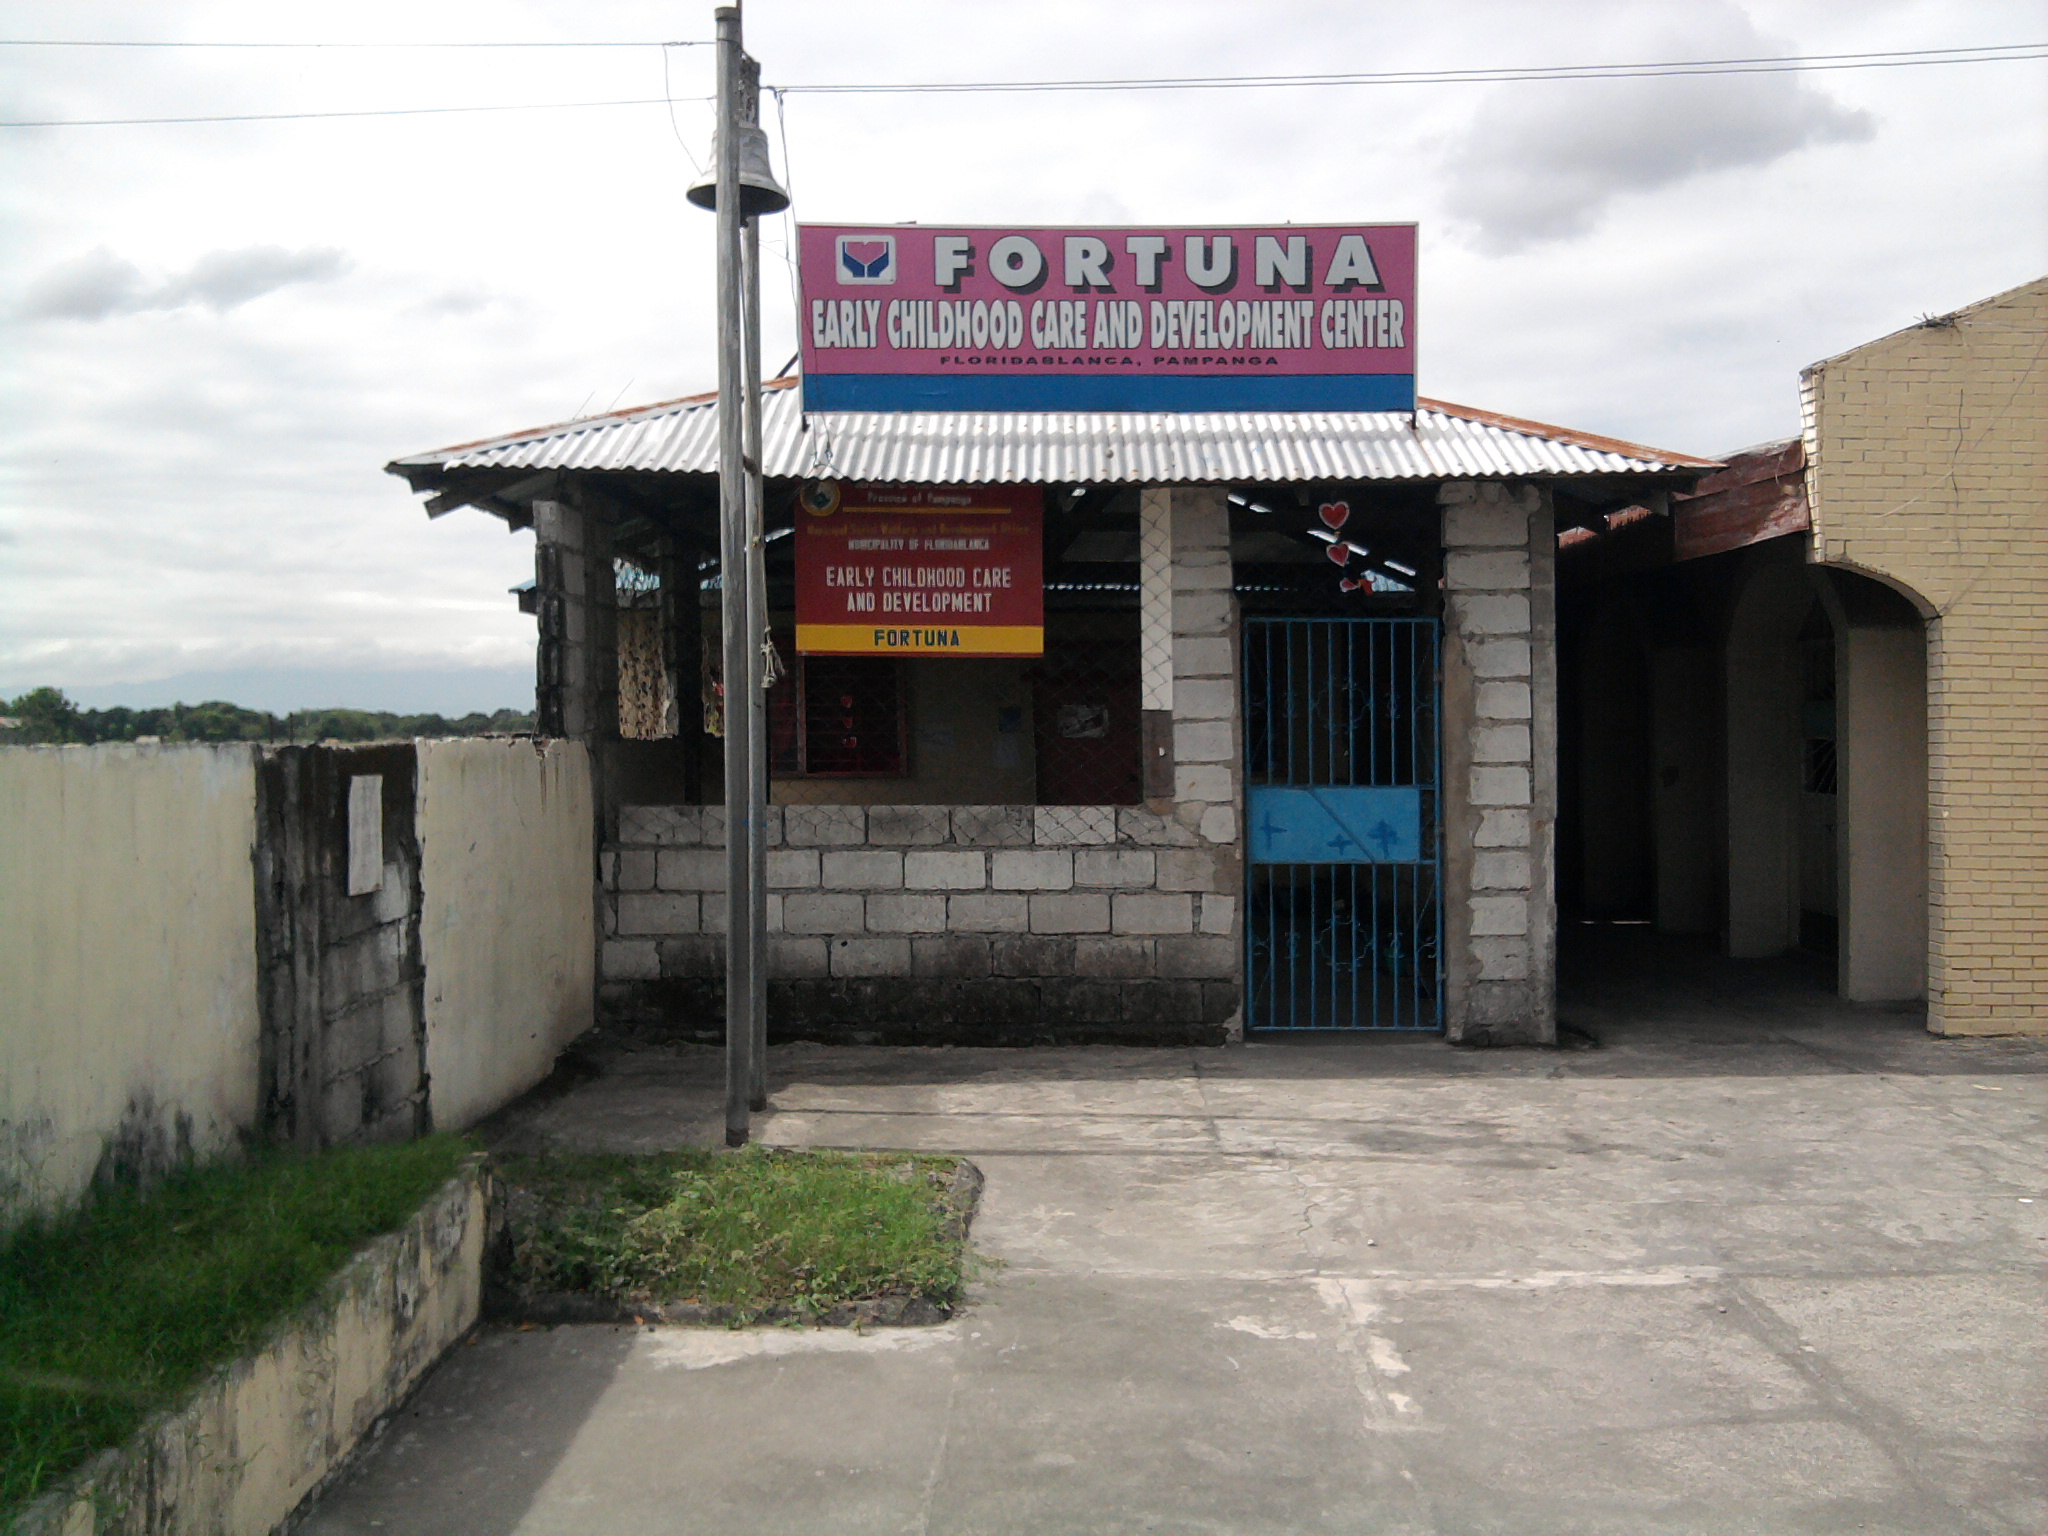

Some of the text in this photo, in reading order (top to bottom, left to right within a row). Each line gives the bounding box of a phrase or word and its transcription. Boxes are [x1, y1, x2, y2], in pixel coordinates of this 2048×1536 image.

[933, 234, 1382, 289] FORTUNA
[811, 299, 1405, 349] EARLY CHILDHOOD CARE AND DEVELOPMENT CENTER
[940, 355, 1280, 367] FLORIDABLANCA, PAMPANGA
[848, 539, 904, 551] MUNICIPALITY
[908, 539, 919, 551] OF
[826, 566, 1012, 588] EARLY CHILDHOOD CARE
[847, 592, 993, 613] AND DEVELOPMENT
[874, 629, 961, 647] FORTUNA
